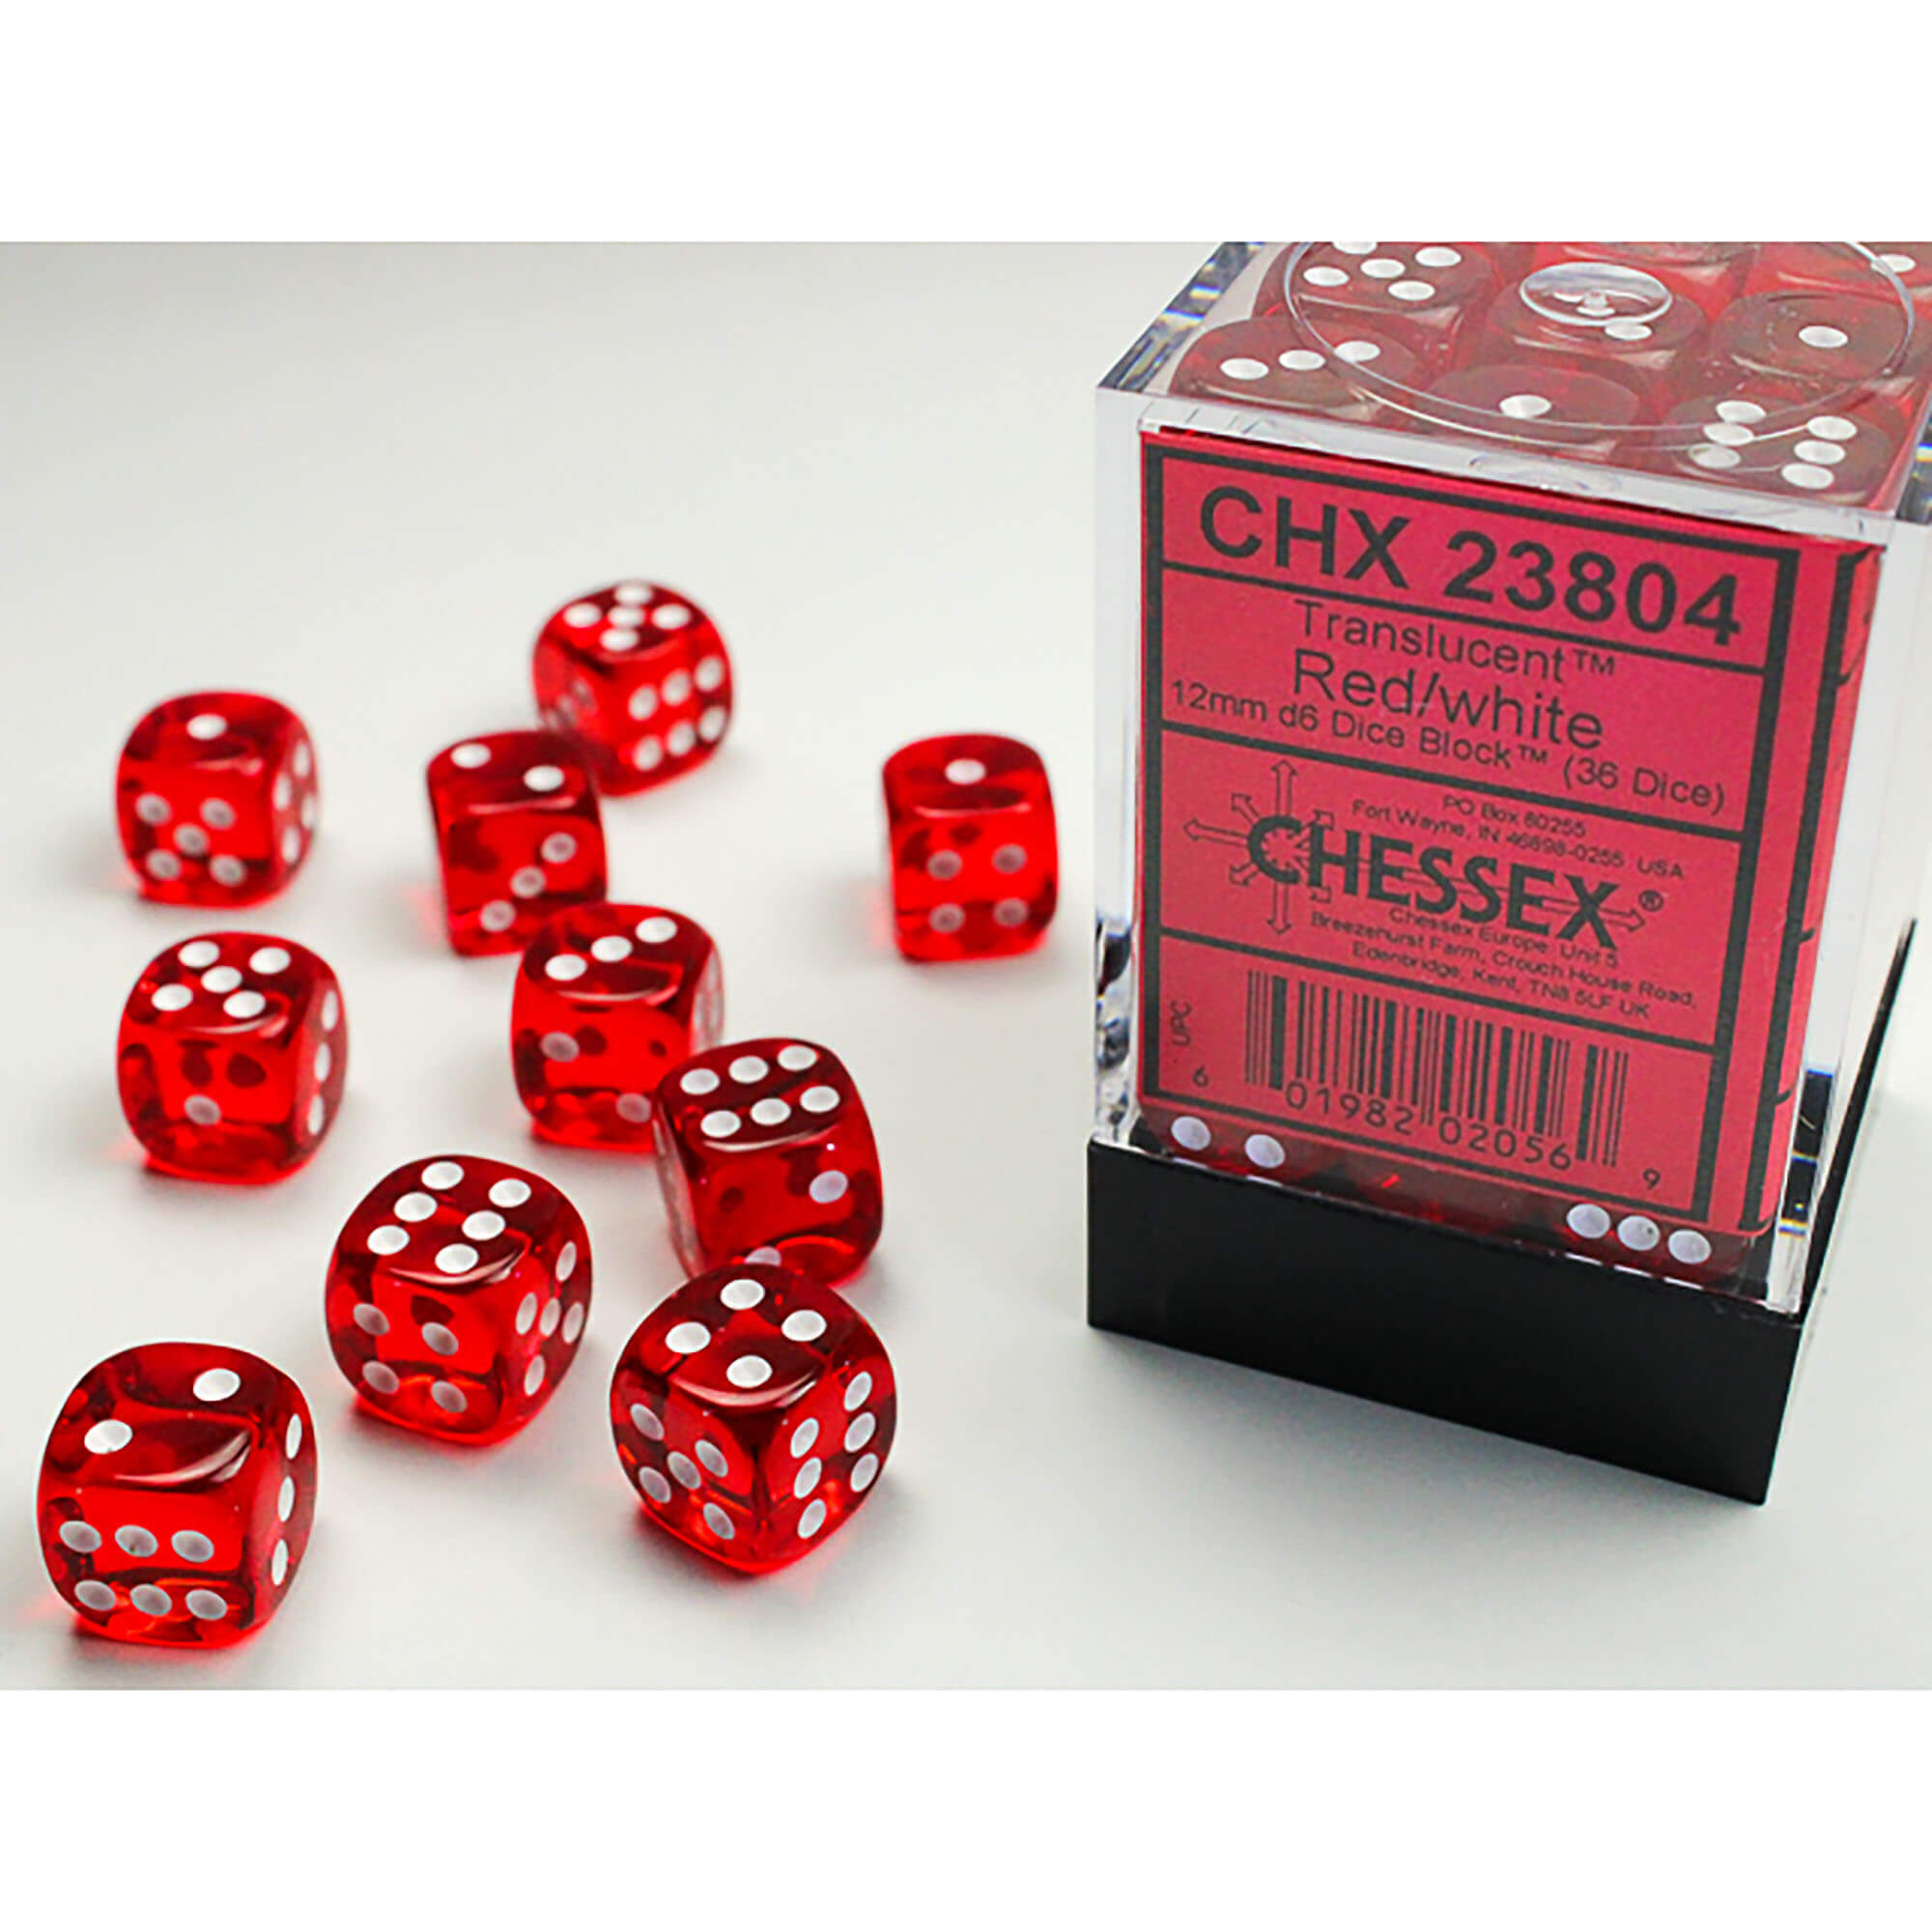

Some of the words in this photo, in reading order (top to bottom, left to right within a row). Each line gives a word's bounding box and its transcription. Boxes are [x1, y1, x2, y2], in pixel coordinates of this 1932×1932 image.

[1200, 486, 1410, 590] CHX
[1443, 529, 1743, 648] 23804
[1294, 599, 1615, 683] Translucent™
[1293, 648, 1604, 750] Red/white
[1172, 679, 1267, 722] 12mm
[1279, 703, 1320, 731] d6
[1332, 709, 1406, 749] Dice
[1562, 754, 1620, 790] (36
[1633, 767, 1725, 816] Dice)
[1352, 798, 1391, 821] Fort
[1397, 808, 1471, 841] Wayne,
[1479, 824, 1501, 843] IN
[1637, 855, 1685, 880] USA
[1443, 794, 1475, 815] PO
[1481, 802, 1520, 824] Box
[1389, 906, 1473, 937] Chessex
[1559, 943, 1602, 965] Unit
[1605, 950, 1619, 969] 5
[1430, 936, 1486, 965] Farm,
[1492, 950, 1564, 979] Crouch
[1569, 967, 1633, 993] House
[1638, 980, 1698, 1009] Road,
[1170, 999, 1193, 1047] UPC
[1472, 968, 1521, 996] Kent,
[1619, 999, 1650, 1019] UK
[1191, 1065, 1209, 1088] 6
[1286, 1080, 1415, 1136] 01982
[1438, 1116, 1573, 1172] 02056
[1642, 1167, 1662, 1191] 9
